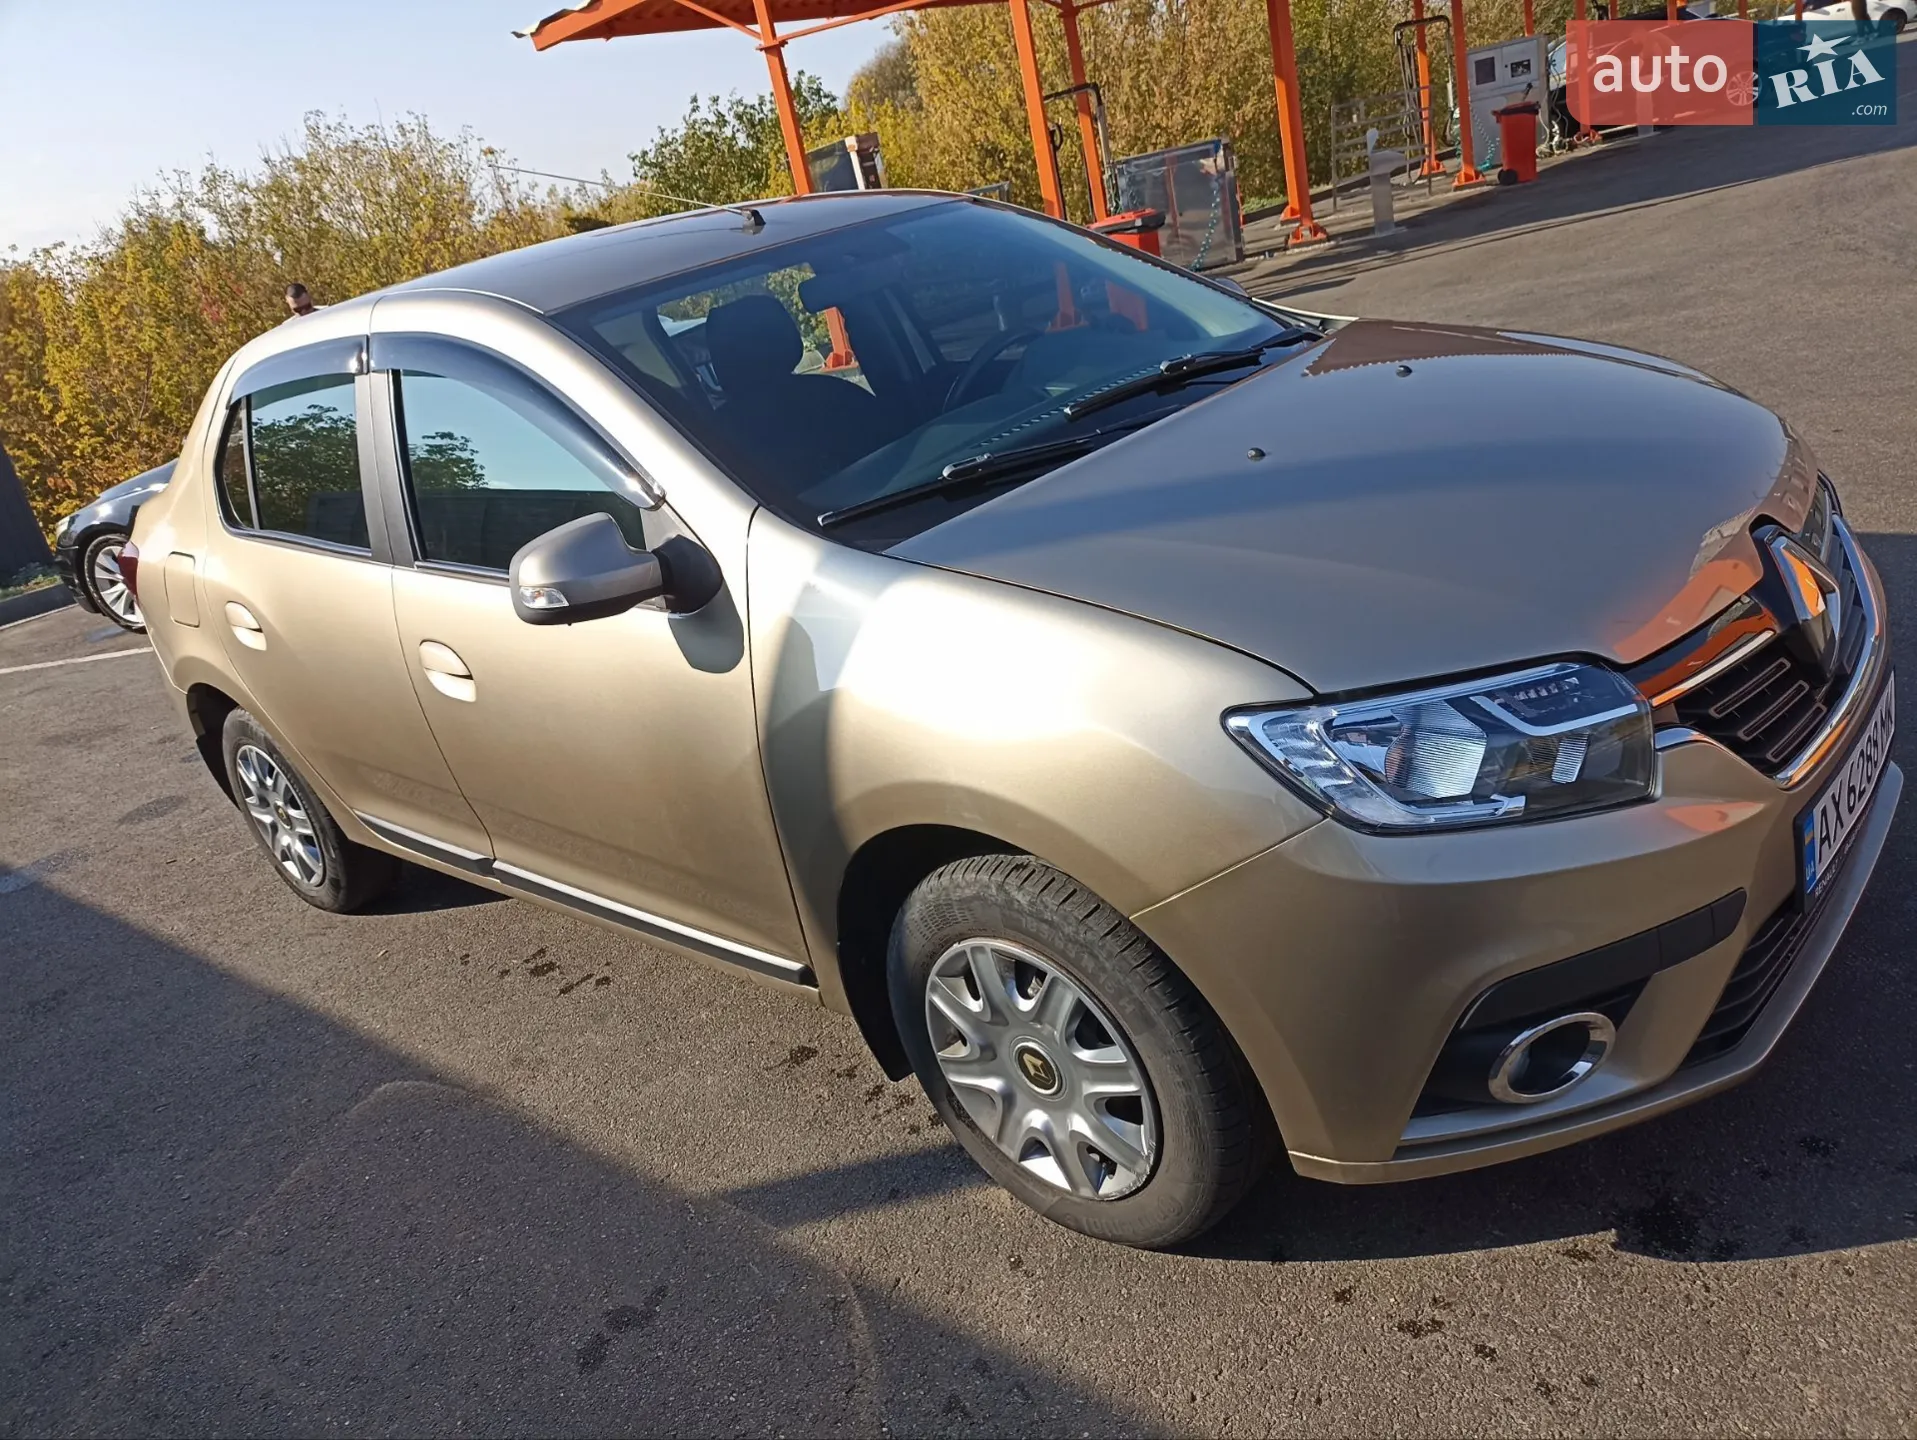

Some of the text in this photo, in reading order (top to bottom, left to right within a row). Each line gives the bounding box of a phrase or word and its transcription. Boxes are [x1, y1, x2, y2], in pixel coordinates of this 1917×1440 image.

[1817, 778, 1844, 865] AX
[1846, 720, 1879, 815] 6288
[1805, 861, 1815, 881] UA
